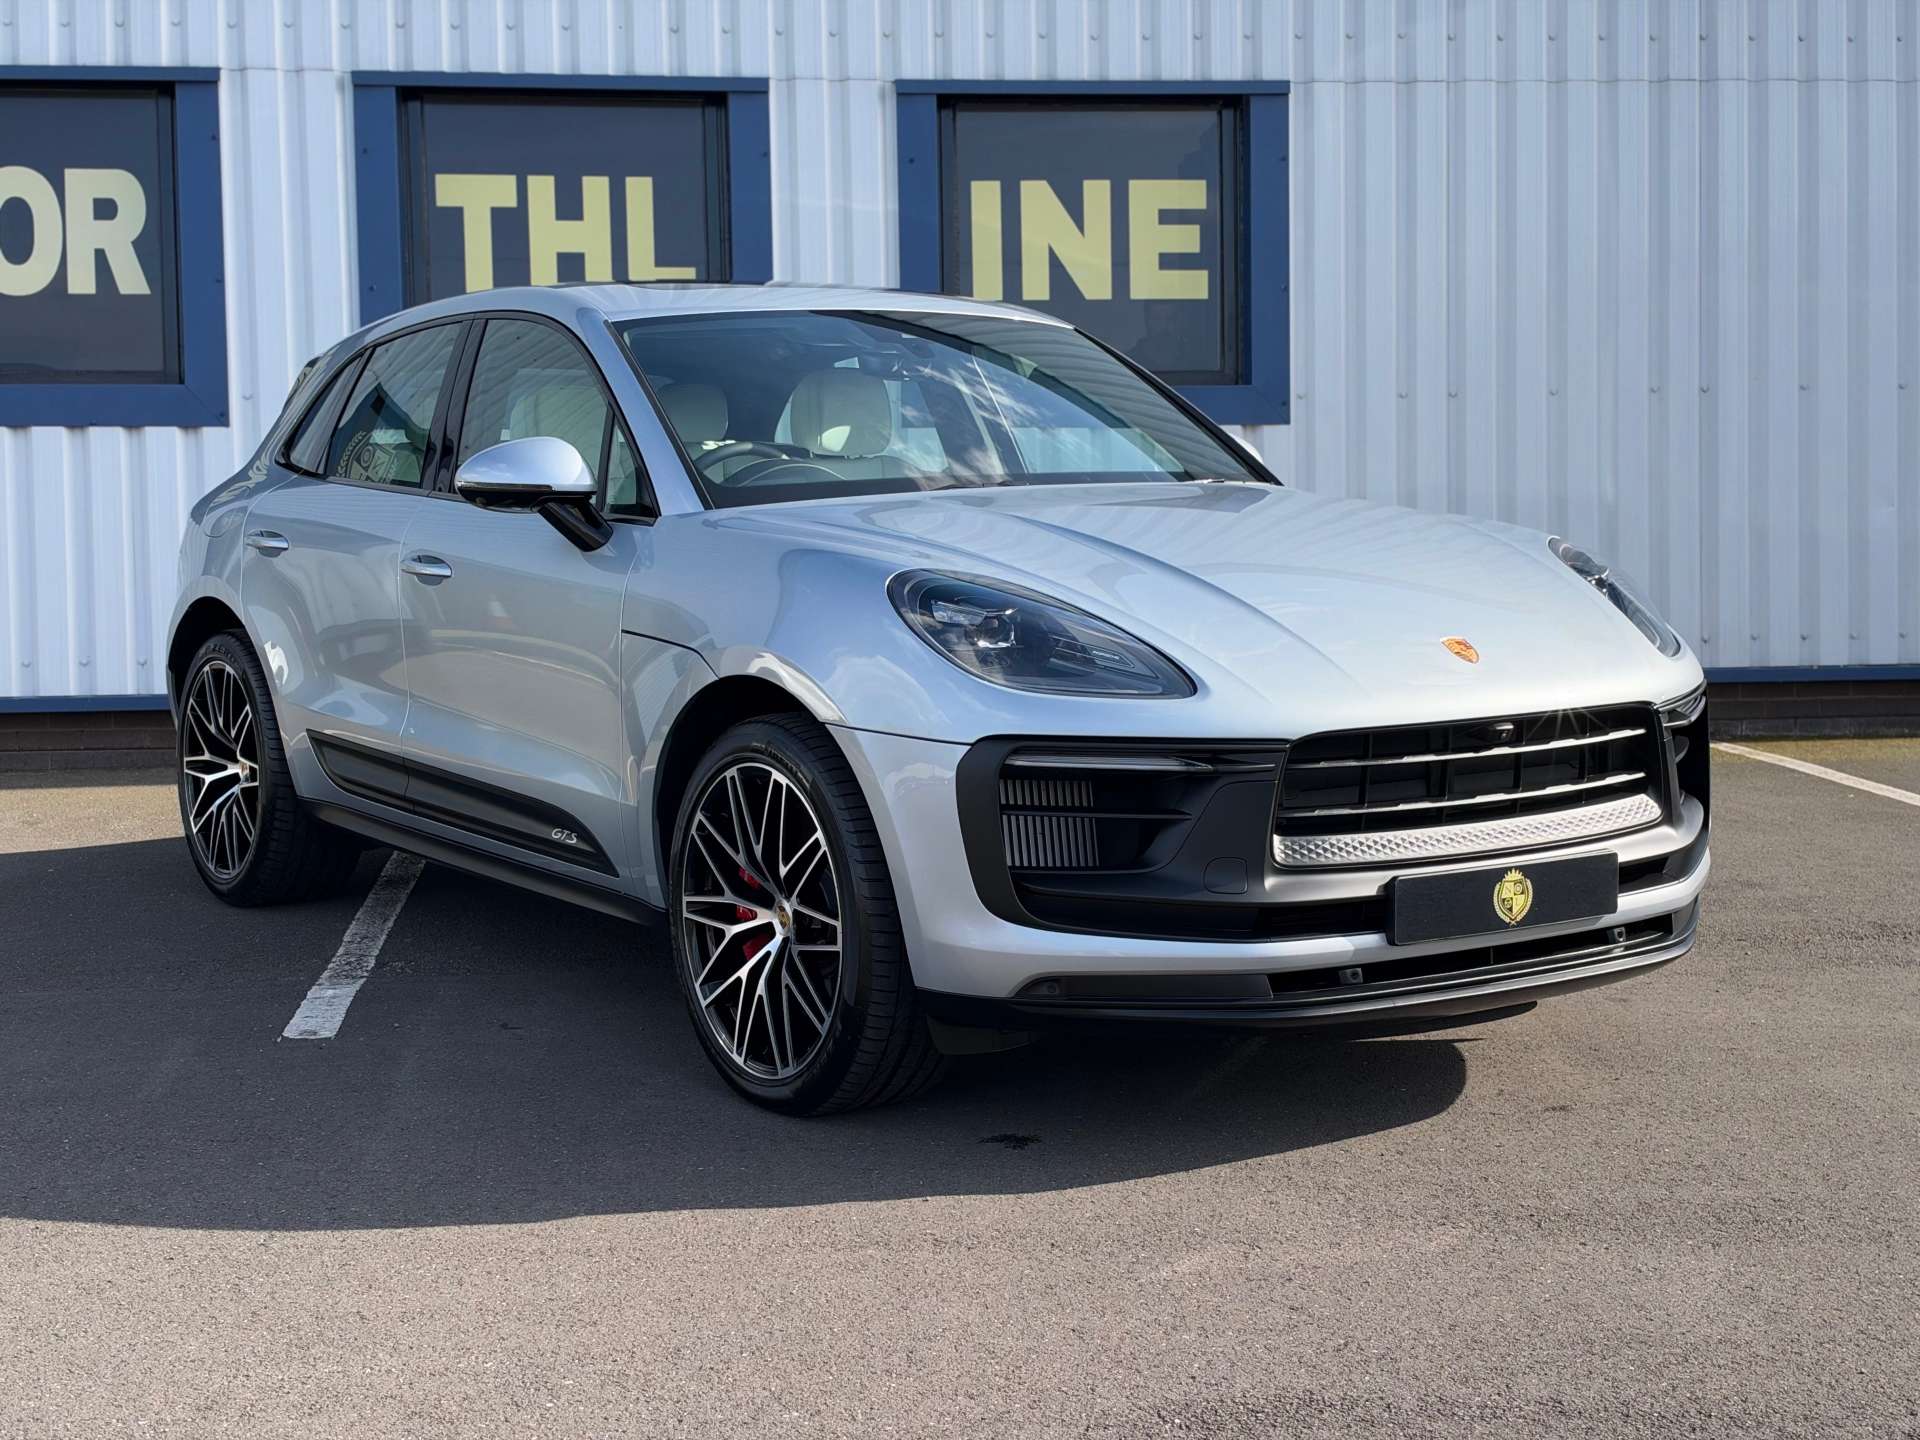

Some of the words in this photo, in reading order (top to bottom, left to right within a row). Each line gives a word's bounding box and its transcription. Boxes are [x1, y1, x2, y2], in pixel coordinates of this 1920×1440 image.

[0, 166, 151, 296] OR
[435, 174, 696, 293] THL
[970, 179, 1209, 300] INE
[551, 828, 578, 844] GTS
